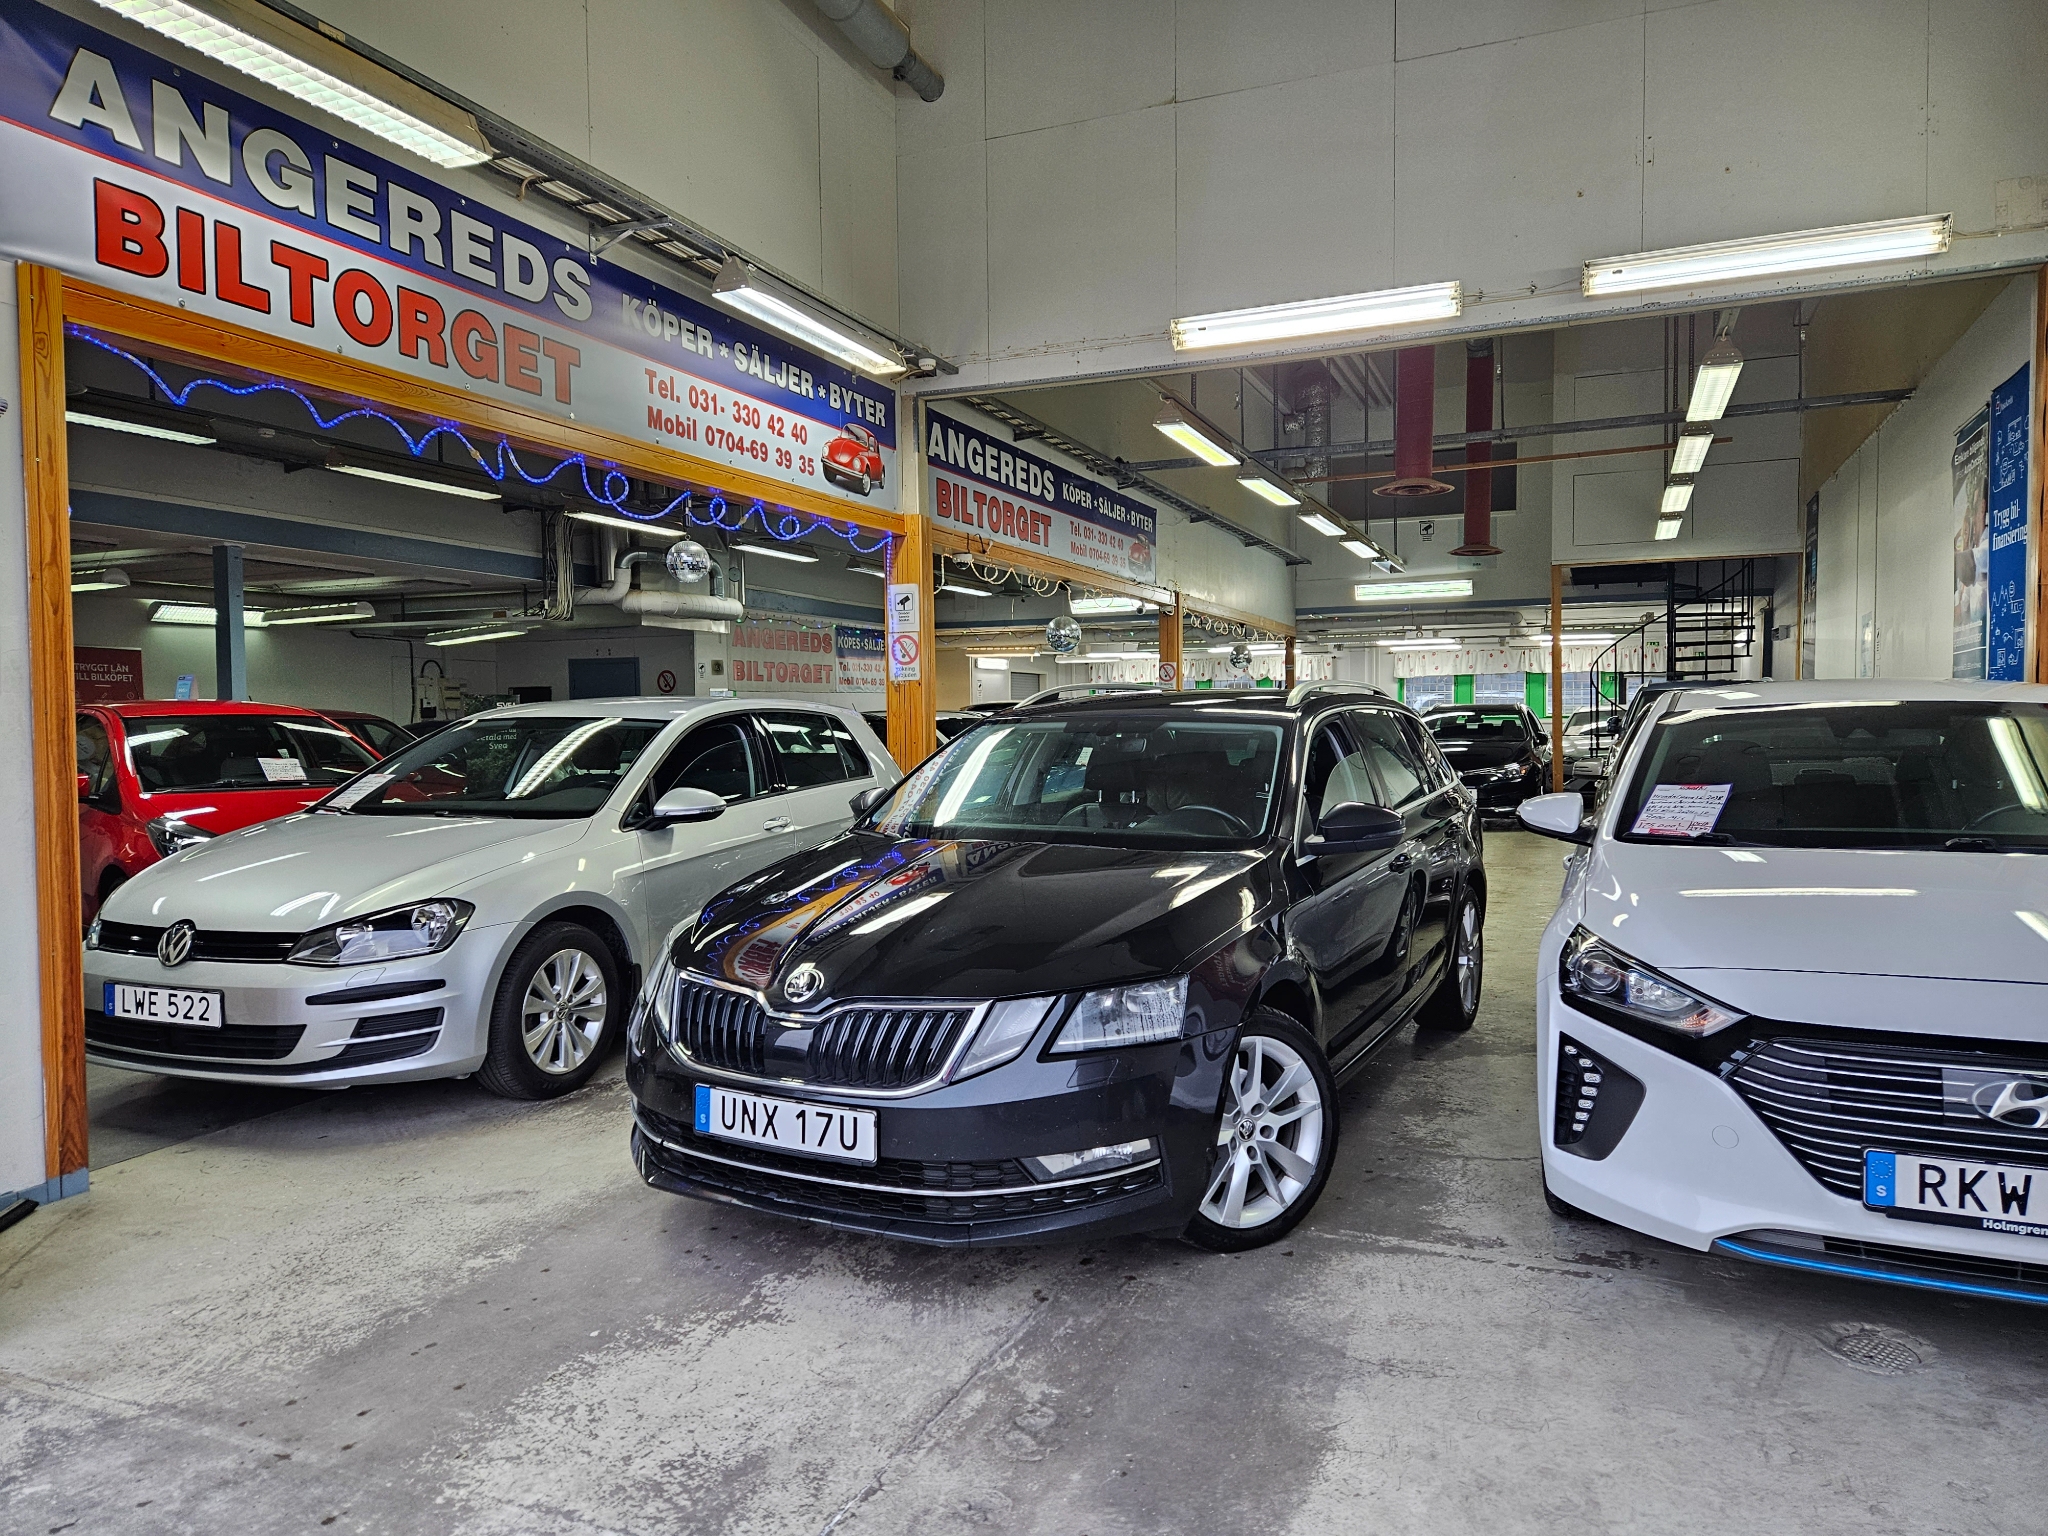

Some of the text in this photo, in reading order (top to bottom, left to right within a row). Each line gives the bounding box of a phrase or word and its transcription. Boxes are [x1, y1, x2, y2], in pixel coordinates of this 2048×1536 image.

[49, 46, 593, 322] ANGEREDS
[93, 177, 581, 405] BILTORGET
[621, 293, 887, 428] KÖPER SÄLJER BYTER
[645, 367, 681, 404] Tel.
[732, 400, 761, 430] 330
[767, 413, 785, 439] 42
[791, 421, 808, 446] 40
[647, 405, 815, 477] Mobil 0704-69 39 35
[928, 422, 1055, 502] ANGEREDS
[936, 476, 1052, 548] BILTORGET
[1062, 480, 1153, 533] KÖPER SÄLJER BYTER
[1069, 519, 1082, 538] Tel.
[1070, 540, 1087, 558] Mobil
[732, 625, 833, 655] ANGEREDS
[74, 662, 129, 673] TRYGGT LÅN
[74, 671, 134, 683] ILL BILKÖPET
[733, 660, 833, 684] BILTORGET
[489, 742, 508, 750] Svea
[121, 988, 210, 1022] LWE 522
[700, 1113, 707, 1124] S
[721, 1095, 858, 1151] UNX 17U
[1876, 1185, 1887, 1197] S
[1918, 1163, 2032, 1217] RKW
[1983, 1218, 2048, 1236] Holmgren
